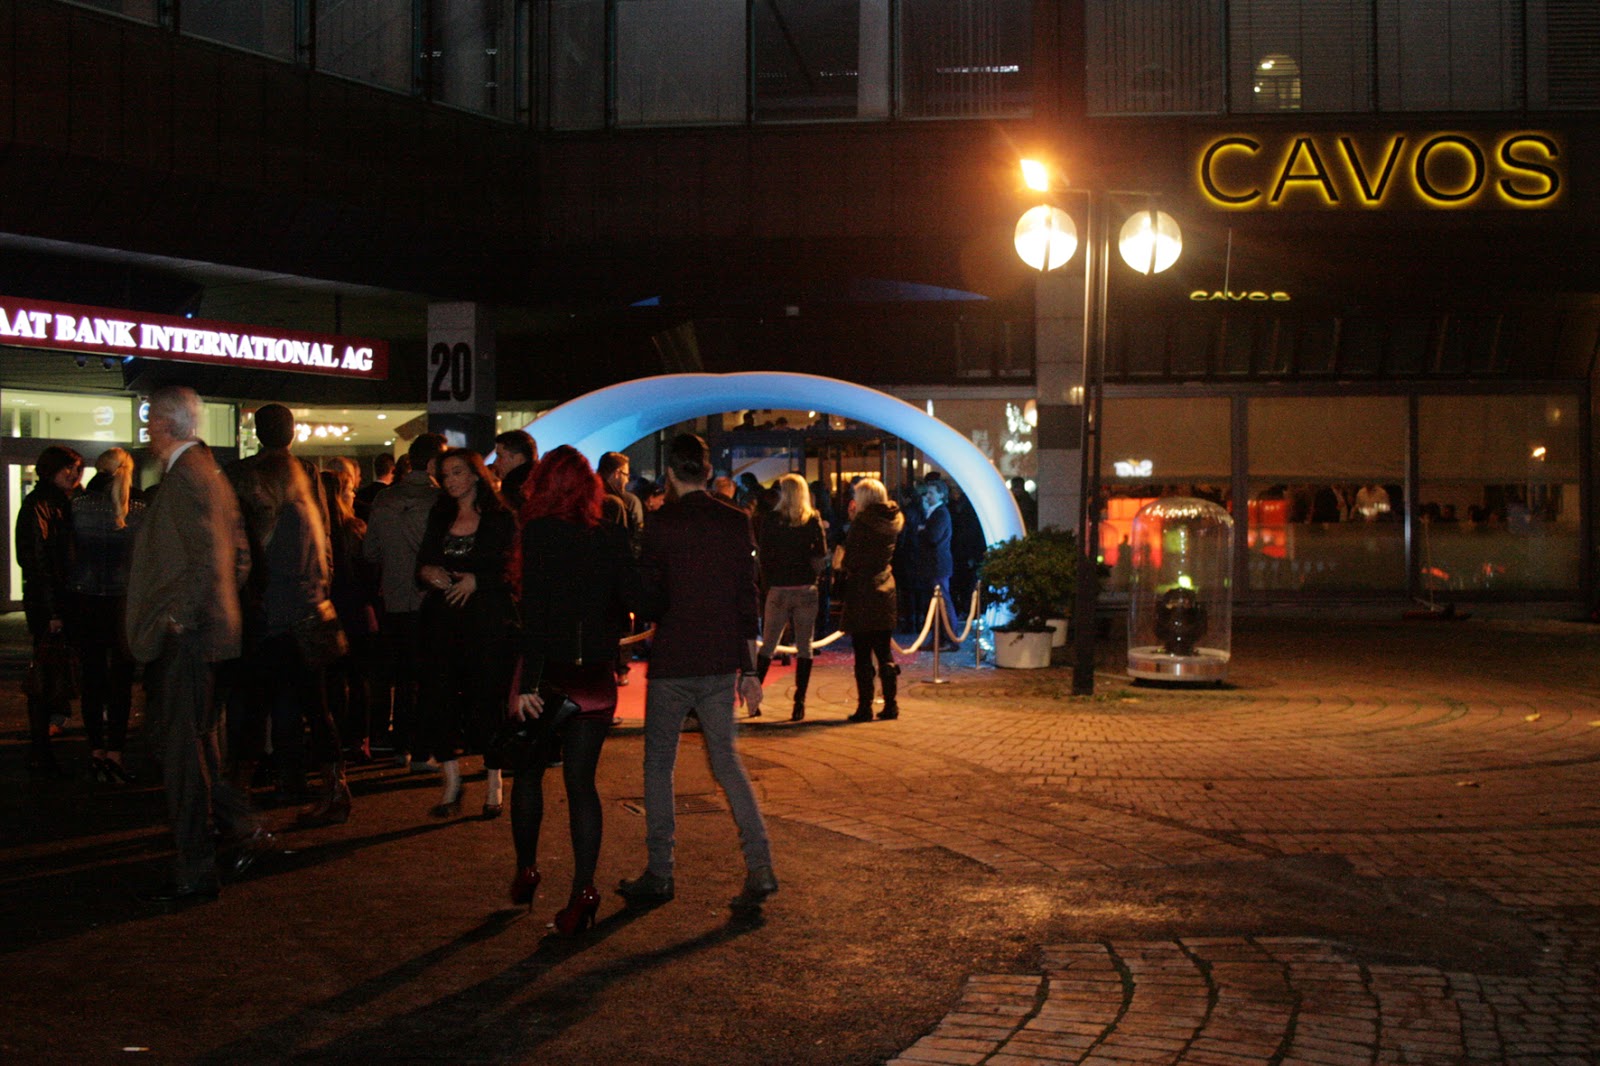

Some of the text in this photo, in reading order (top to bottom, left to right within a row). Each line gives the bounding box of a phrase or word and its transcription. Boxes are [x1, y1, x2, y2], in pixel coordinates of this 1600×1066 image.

[1199, 134, 1563, 206] CAVOS
[1190, 290, 1291, 301] CAVOS
[55, 314, 137, 348] BANK
[139, 323, 339, 368] INTERNATIONAL
[341, 346, 374, 371] AG
[431, 342, 472, 402] 20
